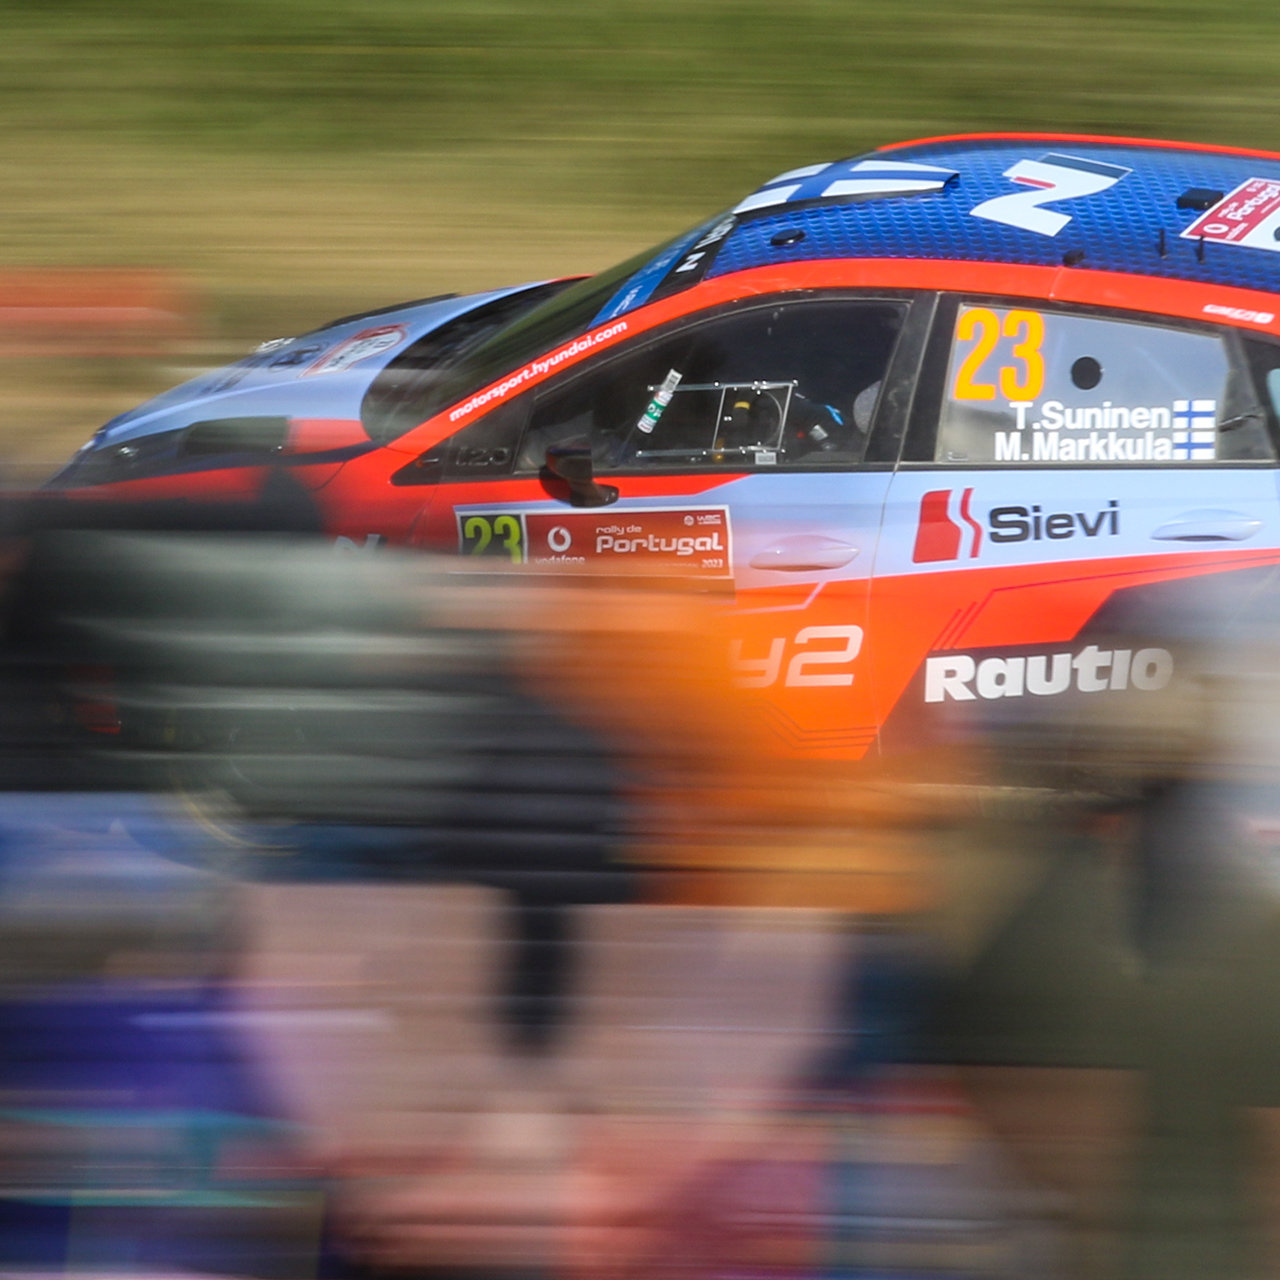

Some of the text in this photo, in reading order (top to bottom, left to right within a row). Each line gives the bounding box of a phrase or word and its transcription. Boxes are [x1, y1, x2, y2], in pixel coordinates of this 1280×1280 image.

[449, 321, 628, 422] motorsport.hyundai.com
[953, 307, 1045, 402] 23
[1009, 401, 1171, 430] T.Suninen
[994, 432, 1171, 461] M.Markkula
[464, 515, 522, 564] 23
[596, 525, 642, 536] rally de
[596, 532, 724, 556] Portugal
[989, 500, 1119, 544] Sievi
[924, 644, 1174, 703] Rautio
